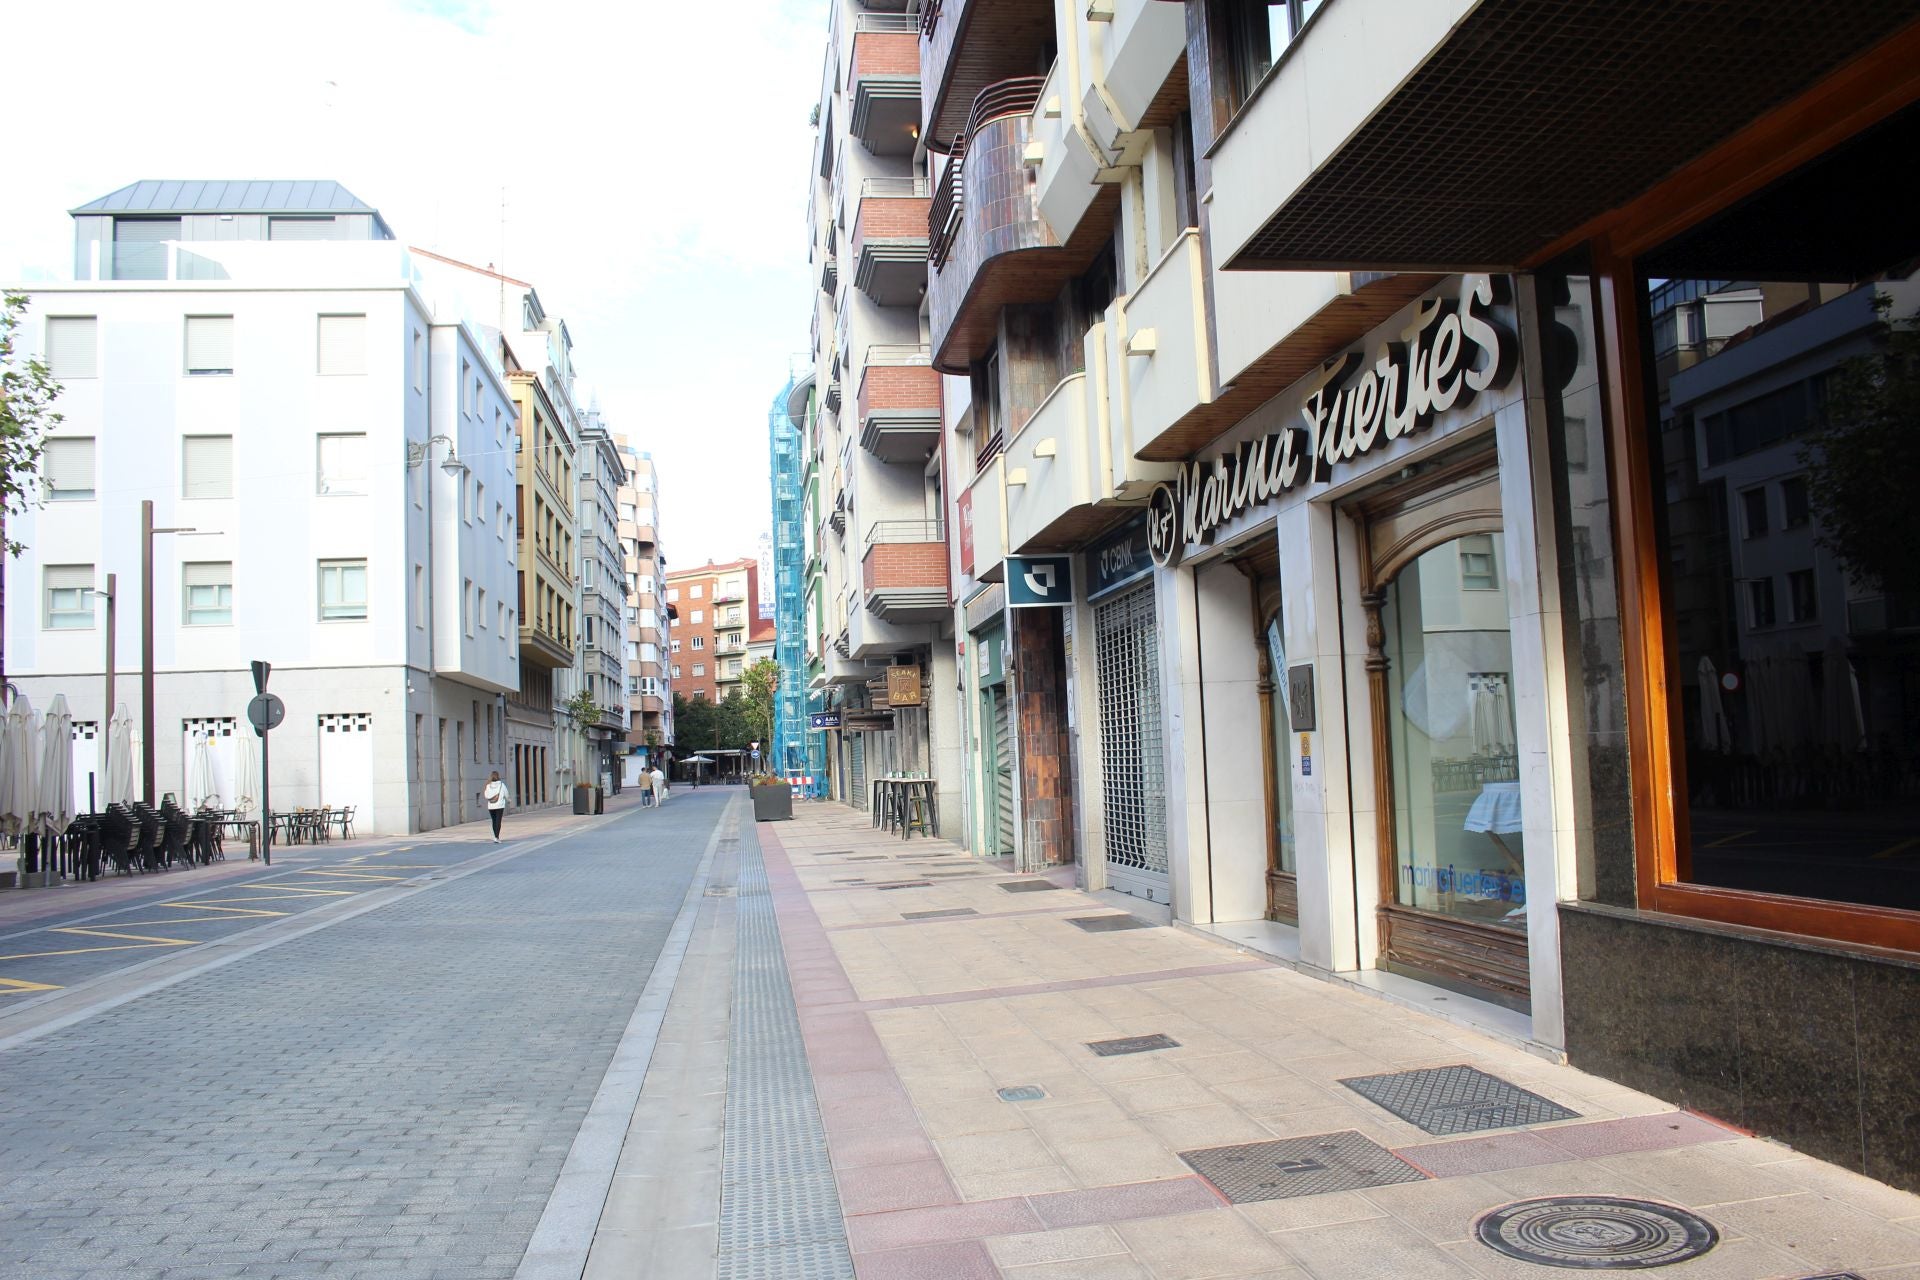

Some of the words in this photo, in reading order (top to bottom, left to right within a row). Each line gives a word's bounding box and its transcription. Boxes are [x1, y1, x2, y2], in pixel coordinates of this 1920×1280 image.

[1176, 427, 1301, 546] Marina
[1301, 274, 1500, 484] Fuertes
[1109, 538, 1133, 573] CBNK
[893, 691, 917, 702] BAR
